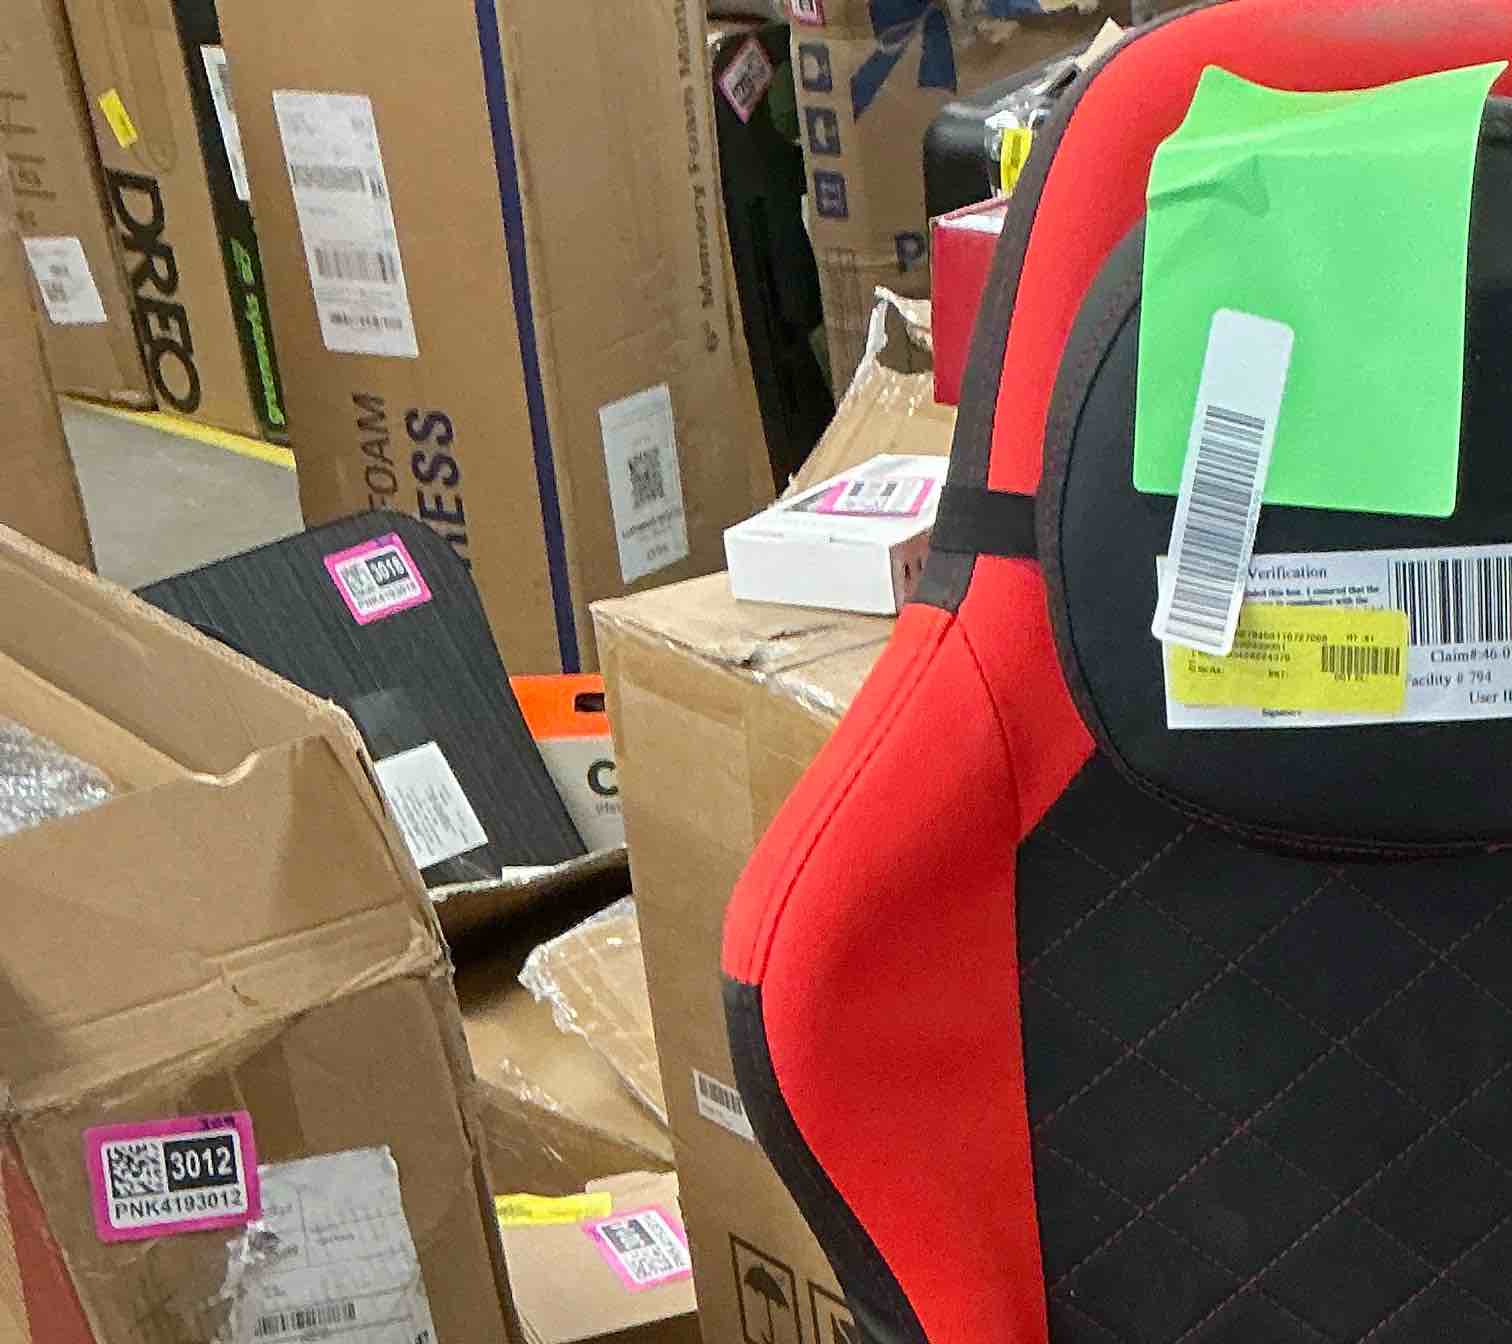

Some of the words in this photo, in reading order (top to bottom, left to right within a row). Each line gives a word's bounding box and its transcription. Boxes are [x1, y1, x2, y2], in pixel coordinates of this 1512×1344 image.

[105, 167, 201, 413] DREO
[1470, 669, 1492, 683] 794
[1469, 690, 1498, 705] User
[169, 1146, 233, 1181] 3012
